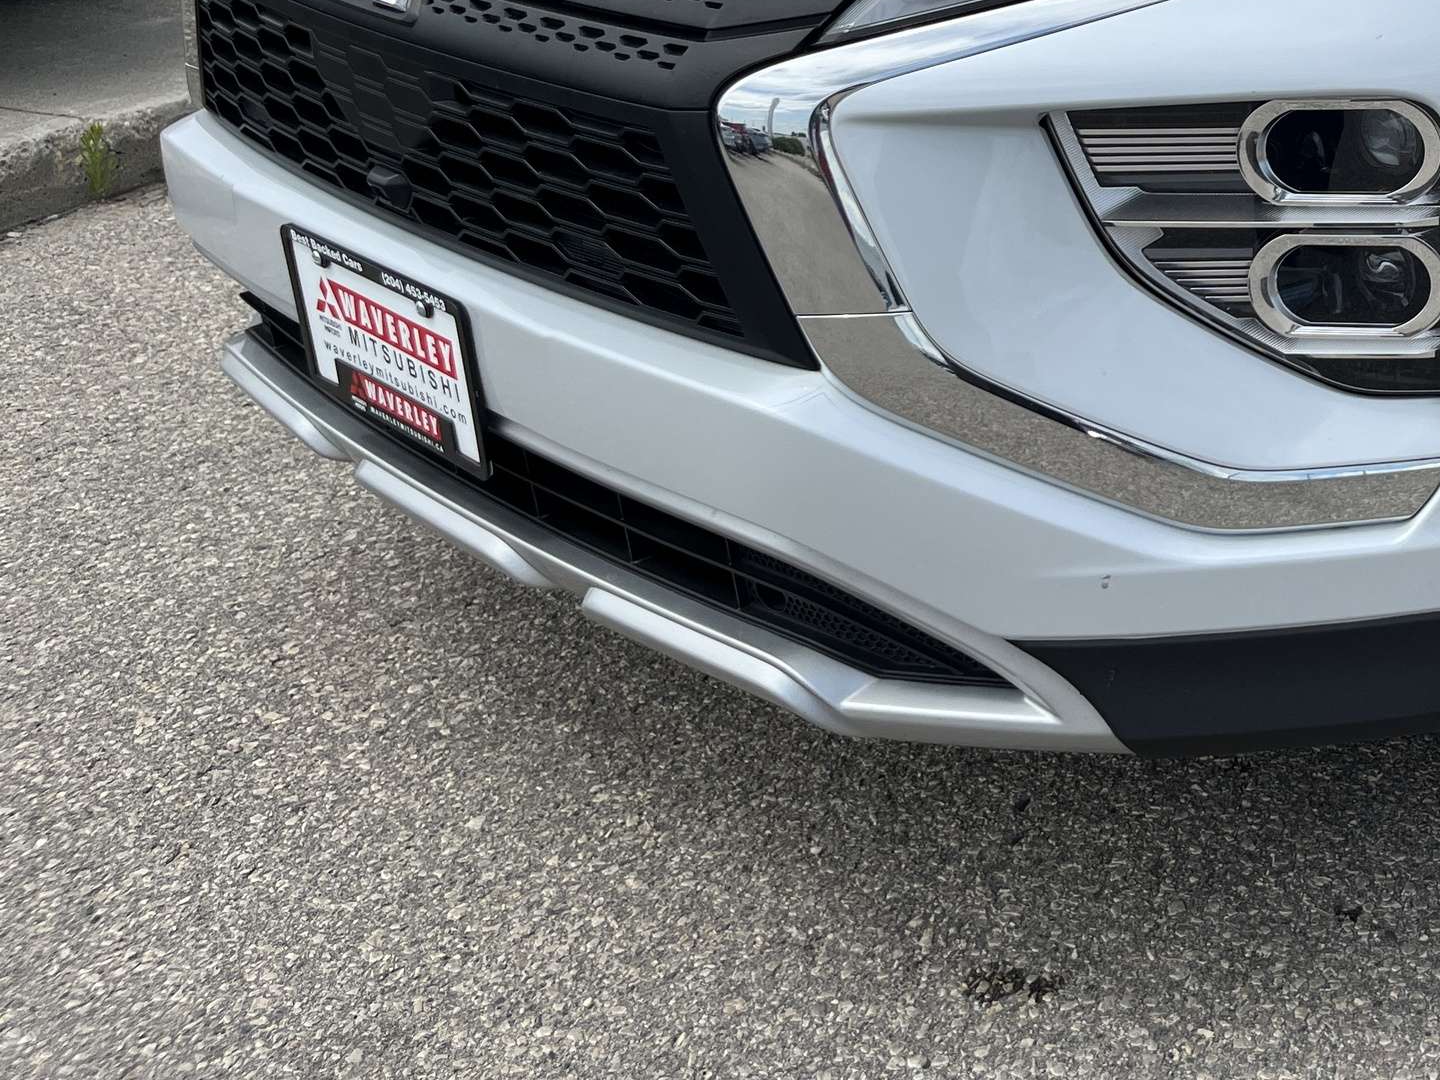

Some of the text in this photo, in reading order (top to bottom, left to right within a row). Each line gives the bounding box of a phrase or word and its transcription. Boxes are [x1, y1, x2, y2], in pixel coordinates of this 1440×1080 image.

[290, 229, 363, 272] Best Backed Cars
[381, 272, 446, 312] (204) 453-5453
[338, 288, 451, 373] WAVERLEY
[347, 326, 461, 403] MITSUBISHI
[364, 378, 439, 437] WAVERLEY
